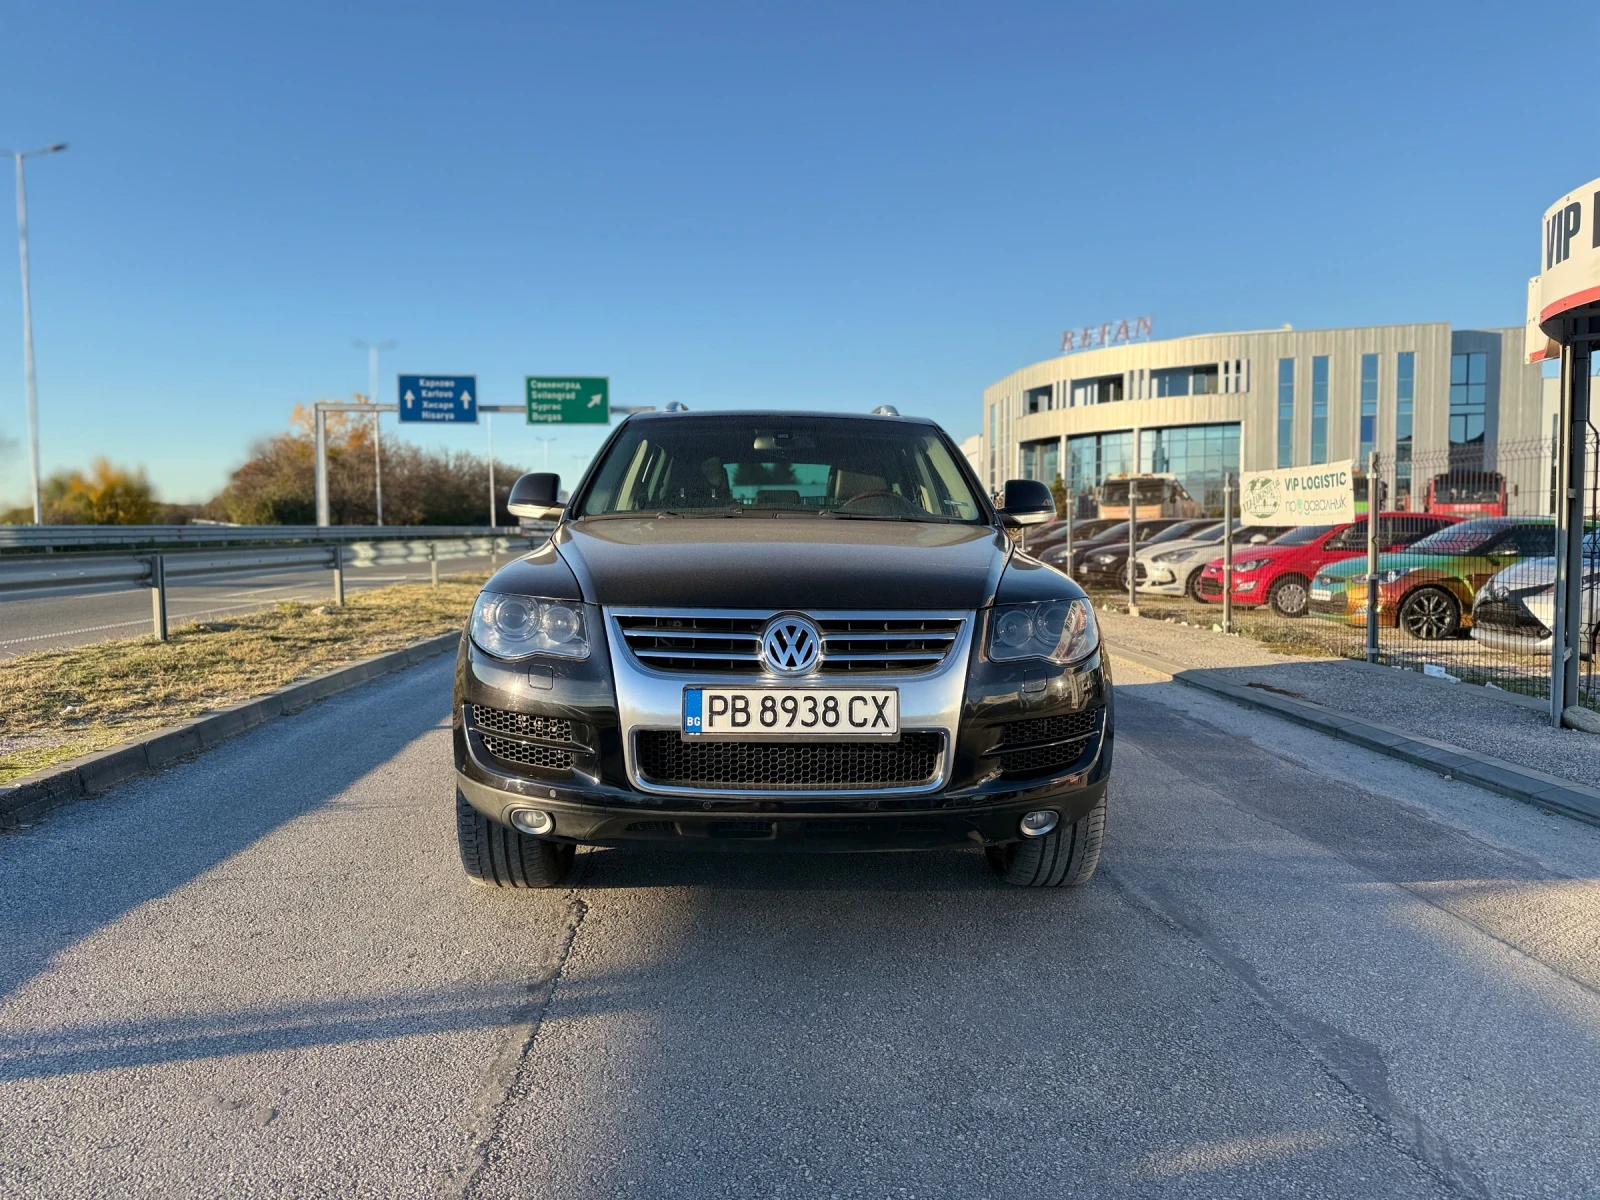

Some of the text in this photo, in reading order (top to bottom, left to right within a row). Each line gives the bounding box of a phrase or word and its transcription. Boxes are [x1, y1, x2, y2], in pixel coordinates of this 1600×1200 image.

[1546, 201, 1581, 271] VIP
[1060, 314, 1153, 351] REFAN
[419, 379, 455, 388] Карлово
[531, 380, 581, 390] Свиленград
[421, 390, 454, 398] Karlovo
[531, 391, 576, 401] Svilengrad
[422, 401, 454, 410] Хисаря
[531, 402, 562, 412] Бургас
[422, 411, 455, 421] Hisarya
[532, 412, 562, 422] Burgas
[1285, 477, 1299, 491] VIP
[1301, 471, 1346, 490] LOGISTIC
[708, 695, 890, 727] PB 8938 CX
[687, 716, 700, 726] BG
